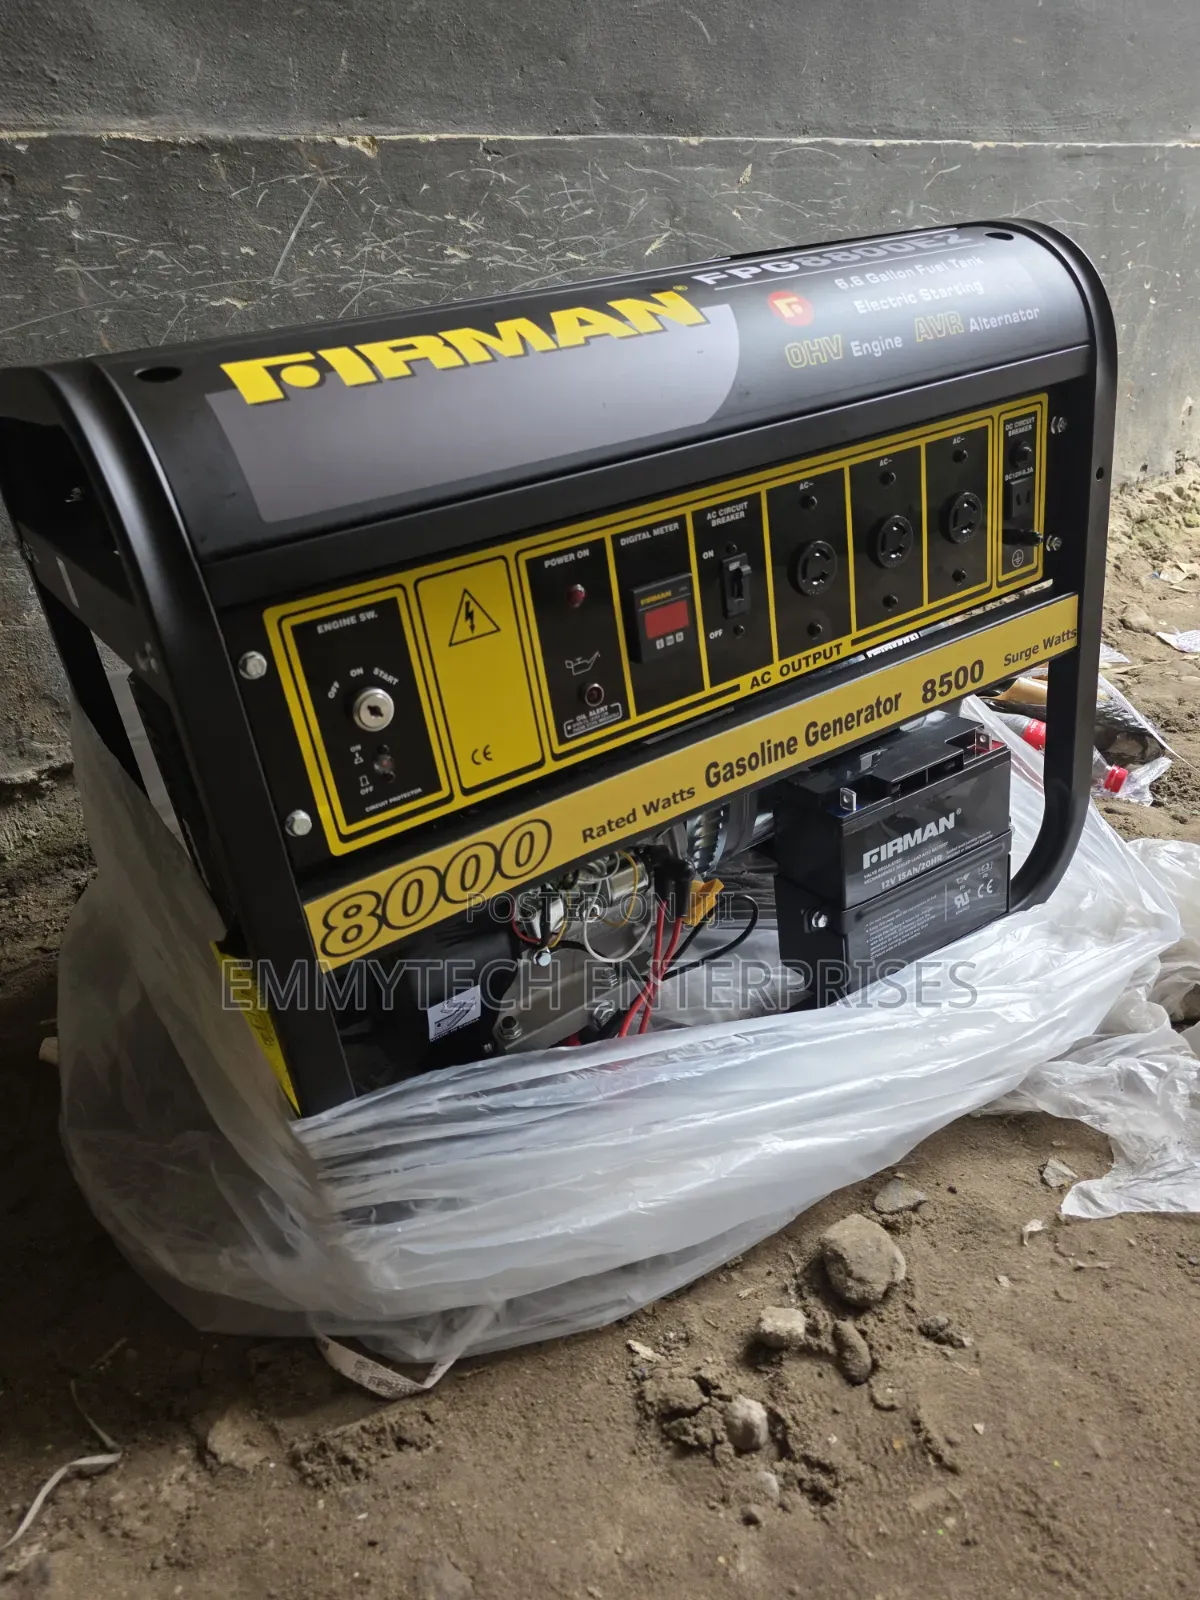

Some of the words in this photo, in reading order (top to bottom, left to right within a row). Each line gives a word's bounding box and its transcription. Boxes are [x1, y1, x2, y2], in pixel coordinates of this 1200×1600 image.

[834, 276, 864, 291] 6.6
[867, 267, 915, 287] Gallon
[915, 260, 949, 277] Fuel
[951, 254, 985, 271] Tank
[853, 290, 917, 315] Electric
[919, 278, 985, 302] Starting
[220, 290, 707, 405] FIRMAN
[784, 334, 844, 369] OHV
[850, 335, 904, 358] Engine
[913, 311, 965, 343] AVR
[968, 306, 1041, 334] Alternator
[1005, 423, 1014, 431] DC
[1014, 416, 1035, 428] CIRCUIT
[706, 510, 718, 521] AC
[718, 501, 748, 518] CIRCUIT
[711, 511, 746, 528] BREAKER
[619, 531, 652, 547] DIGITAL
[652, 522, 680, 537] METER
[544, 553, 576, 569] POWER
[576, 548, 590, 560] ON
[702, 549, 715, 560] ON
[316, 615, 358, 635] ENGINE
[358, 609, 379, 622] SW.
[708, 628, 723, 640] OFF
[349, 666, 364, 678] ON
[372, 667, 400, 686] START
[750, 671, 773, 691] AC
[780, 642, 844, 679] OUTPUT
[327, 680, 340, 699] OFF
[588, 704, 609, 718] ALERT
[349, 743, 362, 753] ON
[471, 744, 493, 766] CE
[319, 818, 553, 958] 8000
[581, 807, 638, 844] Rated
[641, 784, 697, 818] Watts
[704, 733, 799, 790] Gasoline
[803, 689, 903, 749] Generator
[921, 658, 985, 705] 8500
[1002, 642, 1040, 667] Surge
[1042, 628, 1078, 650] Watts
[359, 785, 374, 796] OFF
[364, 800, 389, 813] CIRCUIT
[388, 787, 423, 804] PROTECTOR
[862, 811, 956, 870] FIRMAN
[880, 876, 897, 890] 12V
[897, 854, 943, 882] 15Ah/20HR
